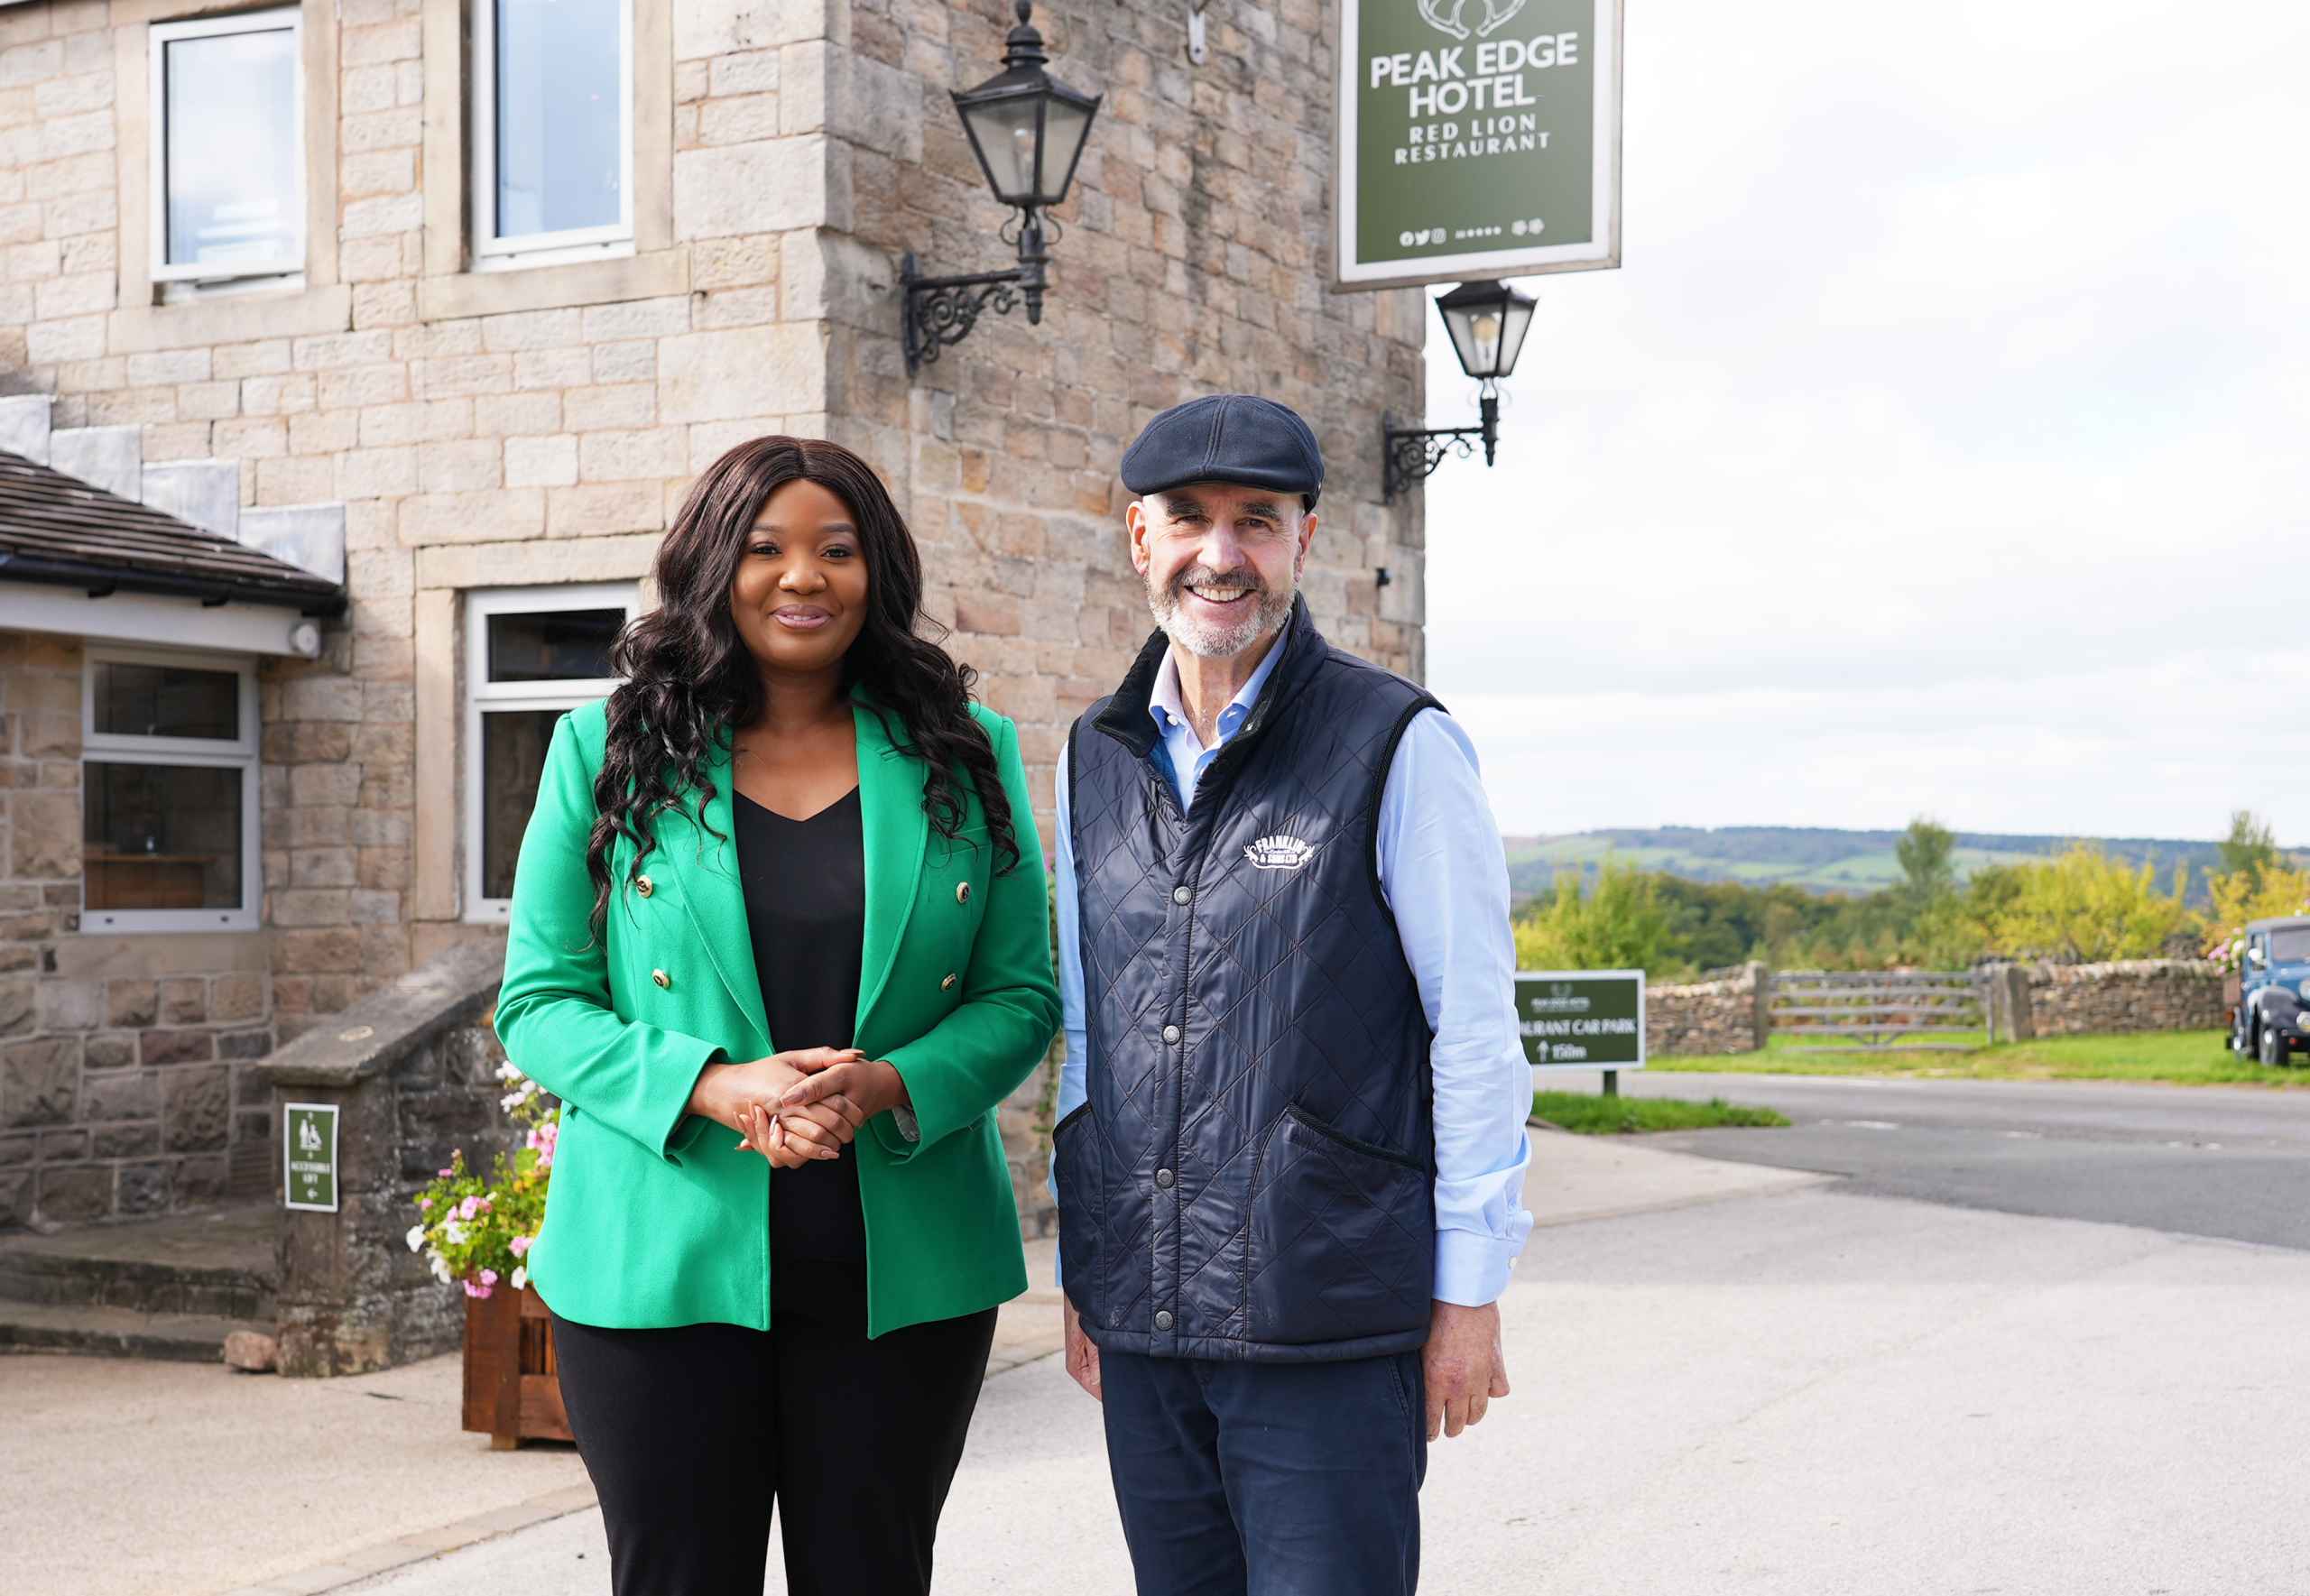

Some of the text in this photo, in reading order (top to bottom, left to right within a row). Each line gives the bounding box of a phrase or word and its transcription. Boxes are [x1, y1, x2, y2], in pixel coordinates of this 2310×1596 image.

[1371, 32, 1578, 88] PEAK EDGE
[1409, 74, 1536, 118] HOTEL
[1409, 114, 1537, 144] RED LION
[1394, 132, 1550, 164] RESTAURANT
[1255, 835, 1307, 853] FRANKLIN
[1572, 1019, 1600, 1036] CAR
[1602, 1018, 1636, 1034] PARK
